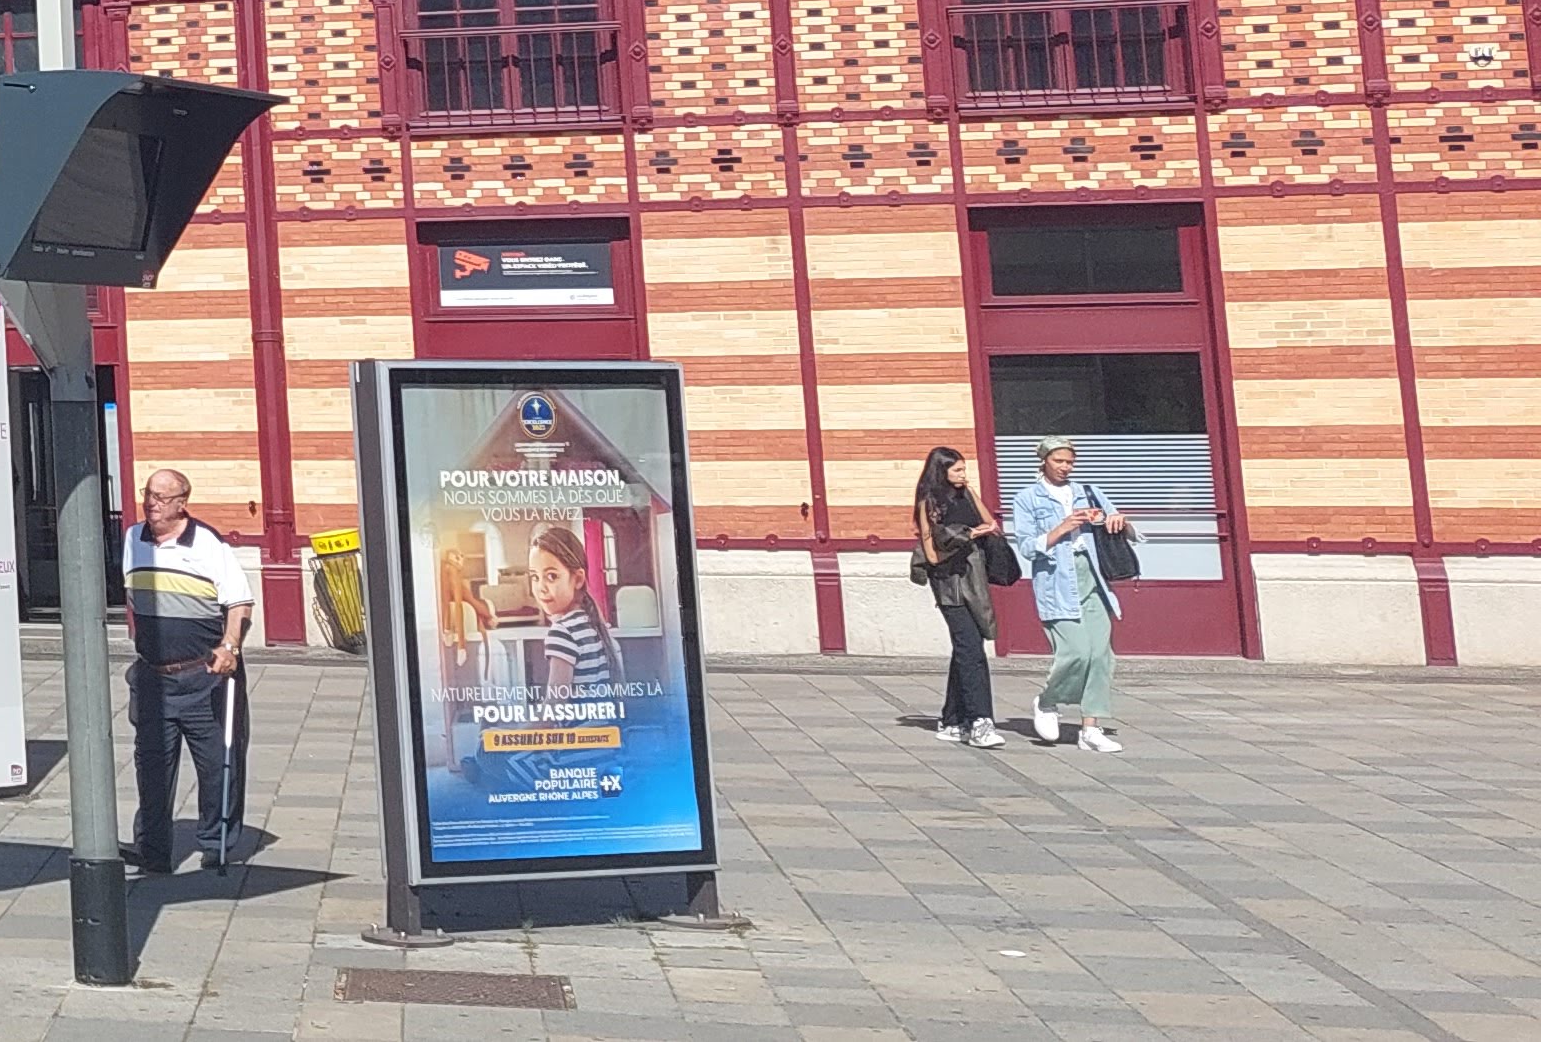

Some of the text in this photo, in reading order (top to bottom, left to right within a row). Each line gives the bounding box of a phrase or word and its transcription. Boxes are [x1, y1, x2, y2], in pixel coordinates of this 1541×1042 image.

[440, 469, 625, 489] POUR VOTRE MAISON,
[444, 487, 624, 505] NOUS SOMMES LÀ DÈS QUE
[481, 507, 520, 522] VOUS
[524, 507, 540, 521] LA
[431, 685, 544, 703] NATURELLEMENT,
[548, 684, 586, 700] NOUS
[647, 679, 663, 696] LÀ
[473, 705, 525, 724] POUR
[546, 732, 564, 745] SUR
[549, 767, 597, 778] BANQUE
[534, 778, 598, 791] POPULAIRE
[488, 792, 538, 803] AUVERGNE
[572, 790, 599, 800] ALPES
